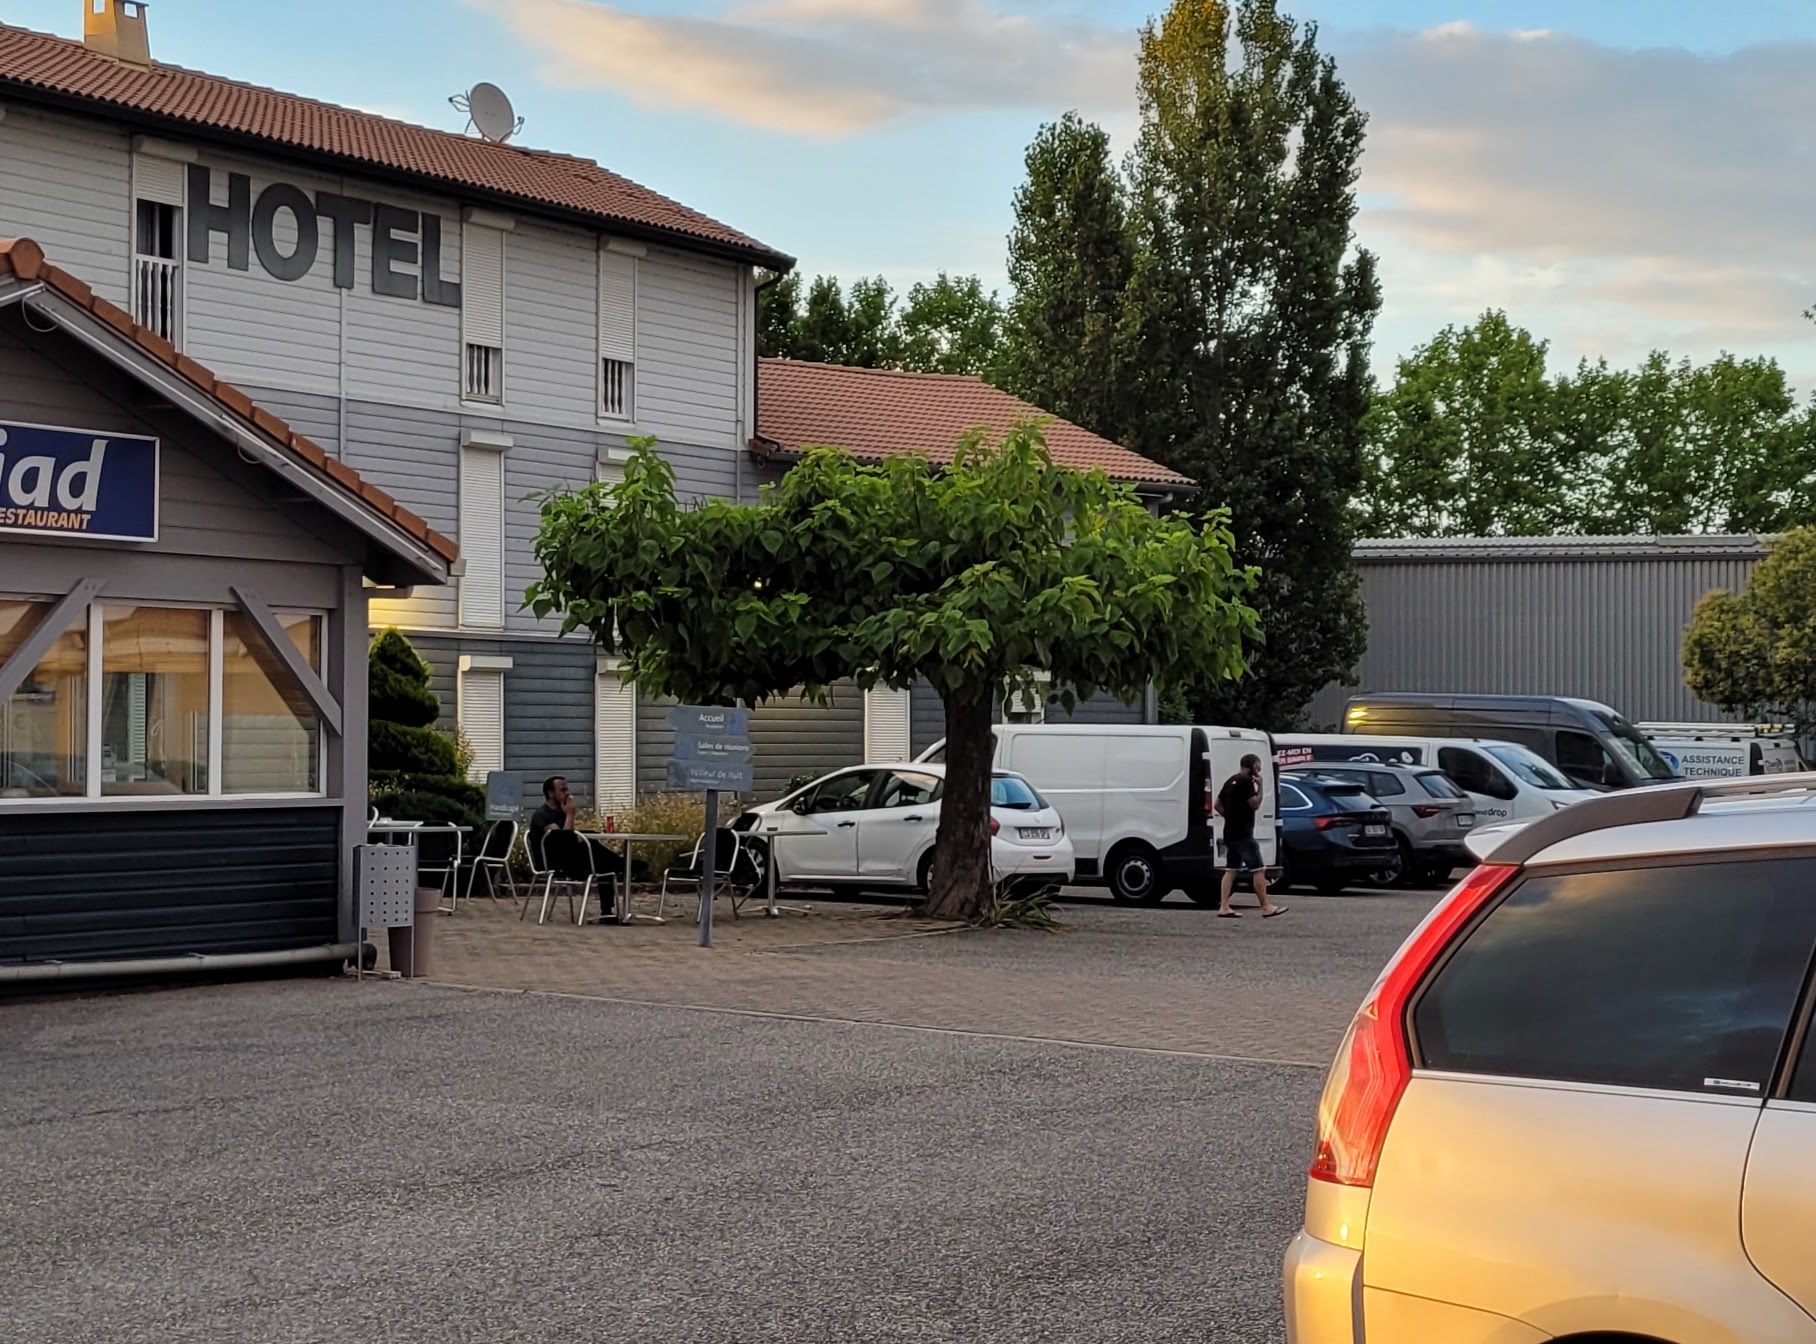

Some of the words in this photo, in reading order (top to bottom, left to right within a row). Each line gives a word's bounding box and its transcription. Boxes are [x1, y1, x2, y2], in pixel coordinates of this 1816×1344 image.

[187, 162, 462, 308] HOTEL
[699, 713, 725, 722] Accueil
[1682, 754, 1744, 765] ASSISTANCE
[1683, 767, 1742, 777] TECHNIQUE
